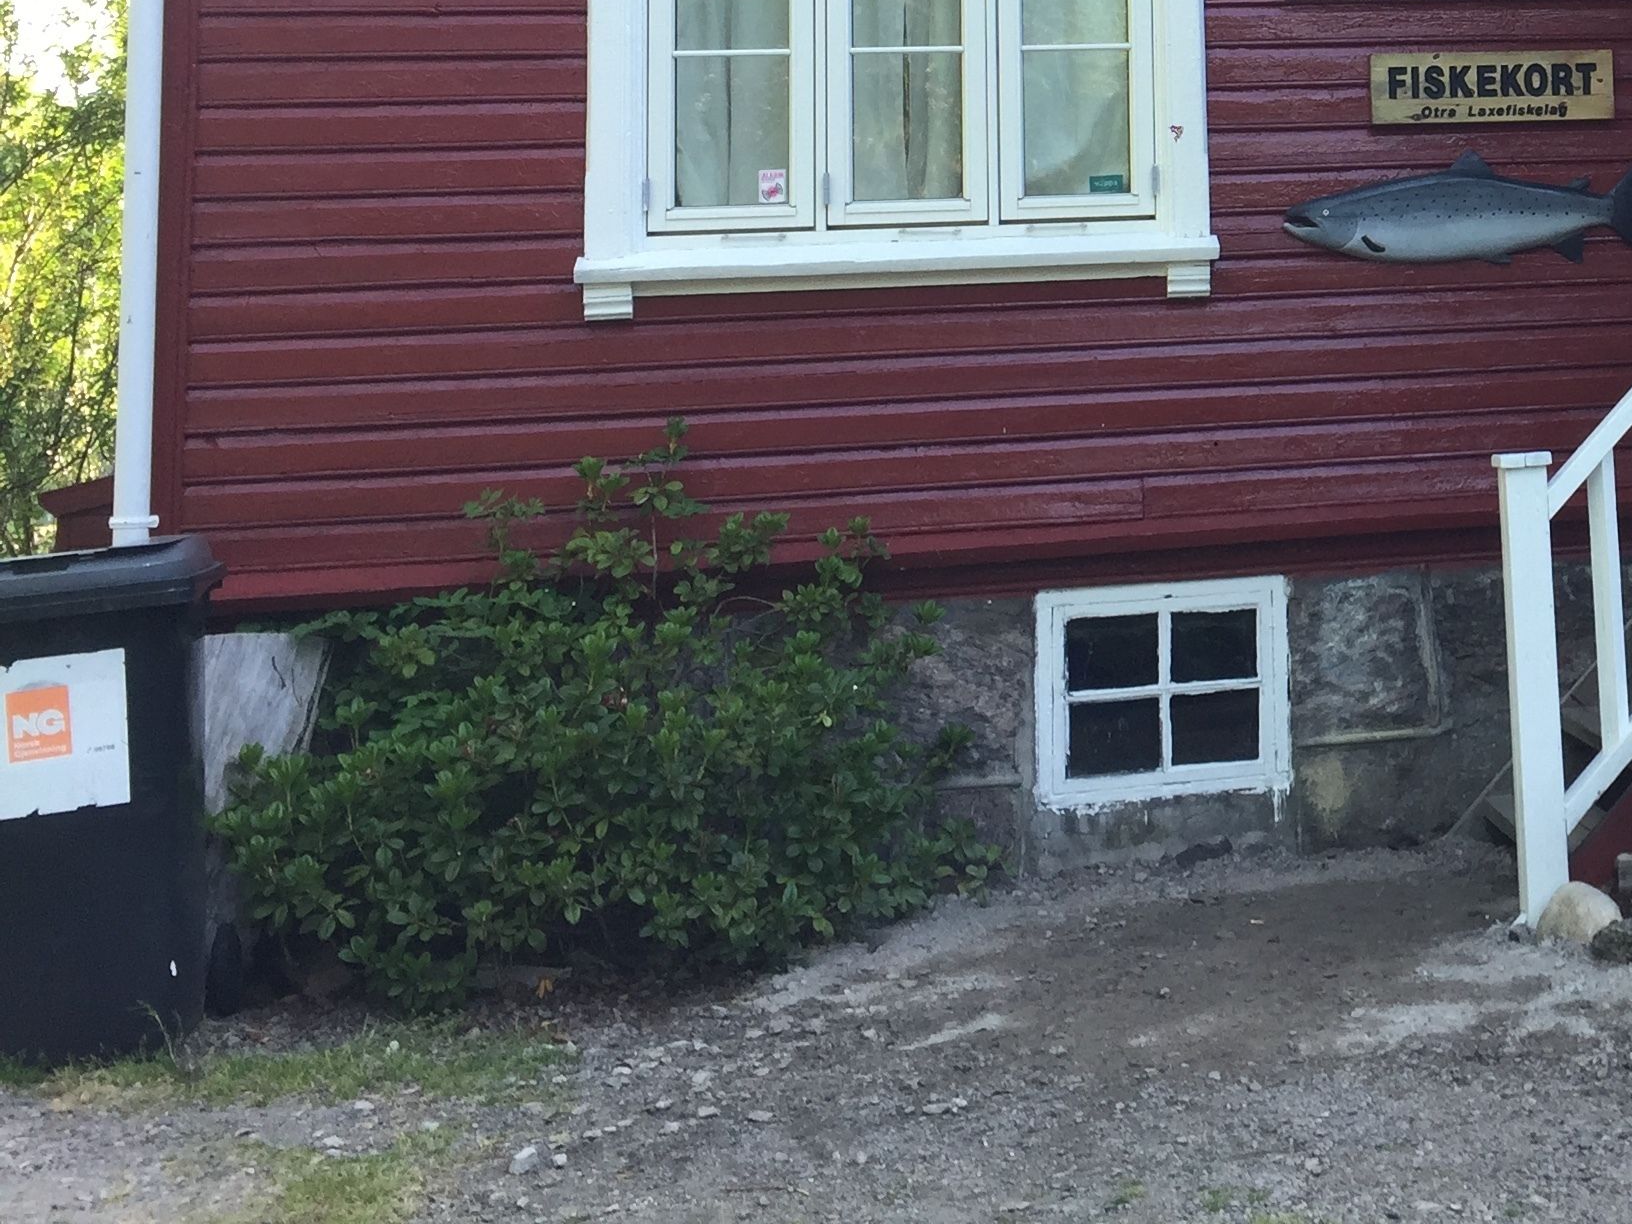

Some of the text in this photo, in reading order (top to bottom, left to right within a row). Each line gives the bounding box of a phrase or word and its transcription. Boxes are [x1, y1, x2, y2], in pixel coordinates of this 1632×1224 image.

[1387, 62, 1597, 100] FISKEKORT
[1420, 101, 1569, 120] Otra Laxefiskelag
[12, 708, 65, 739] NG
